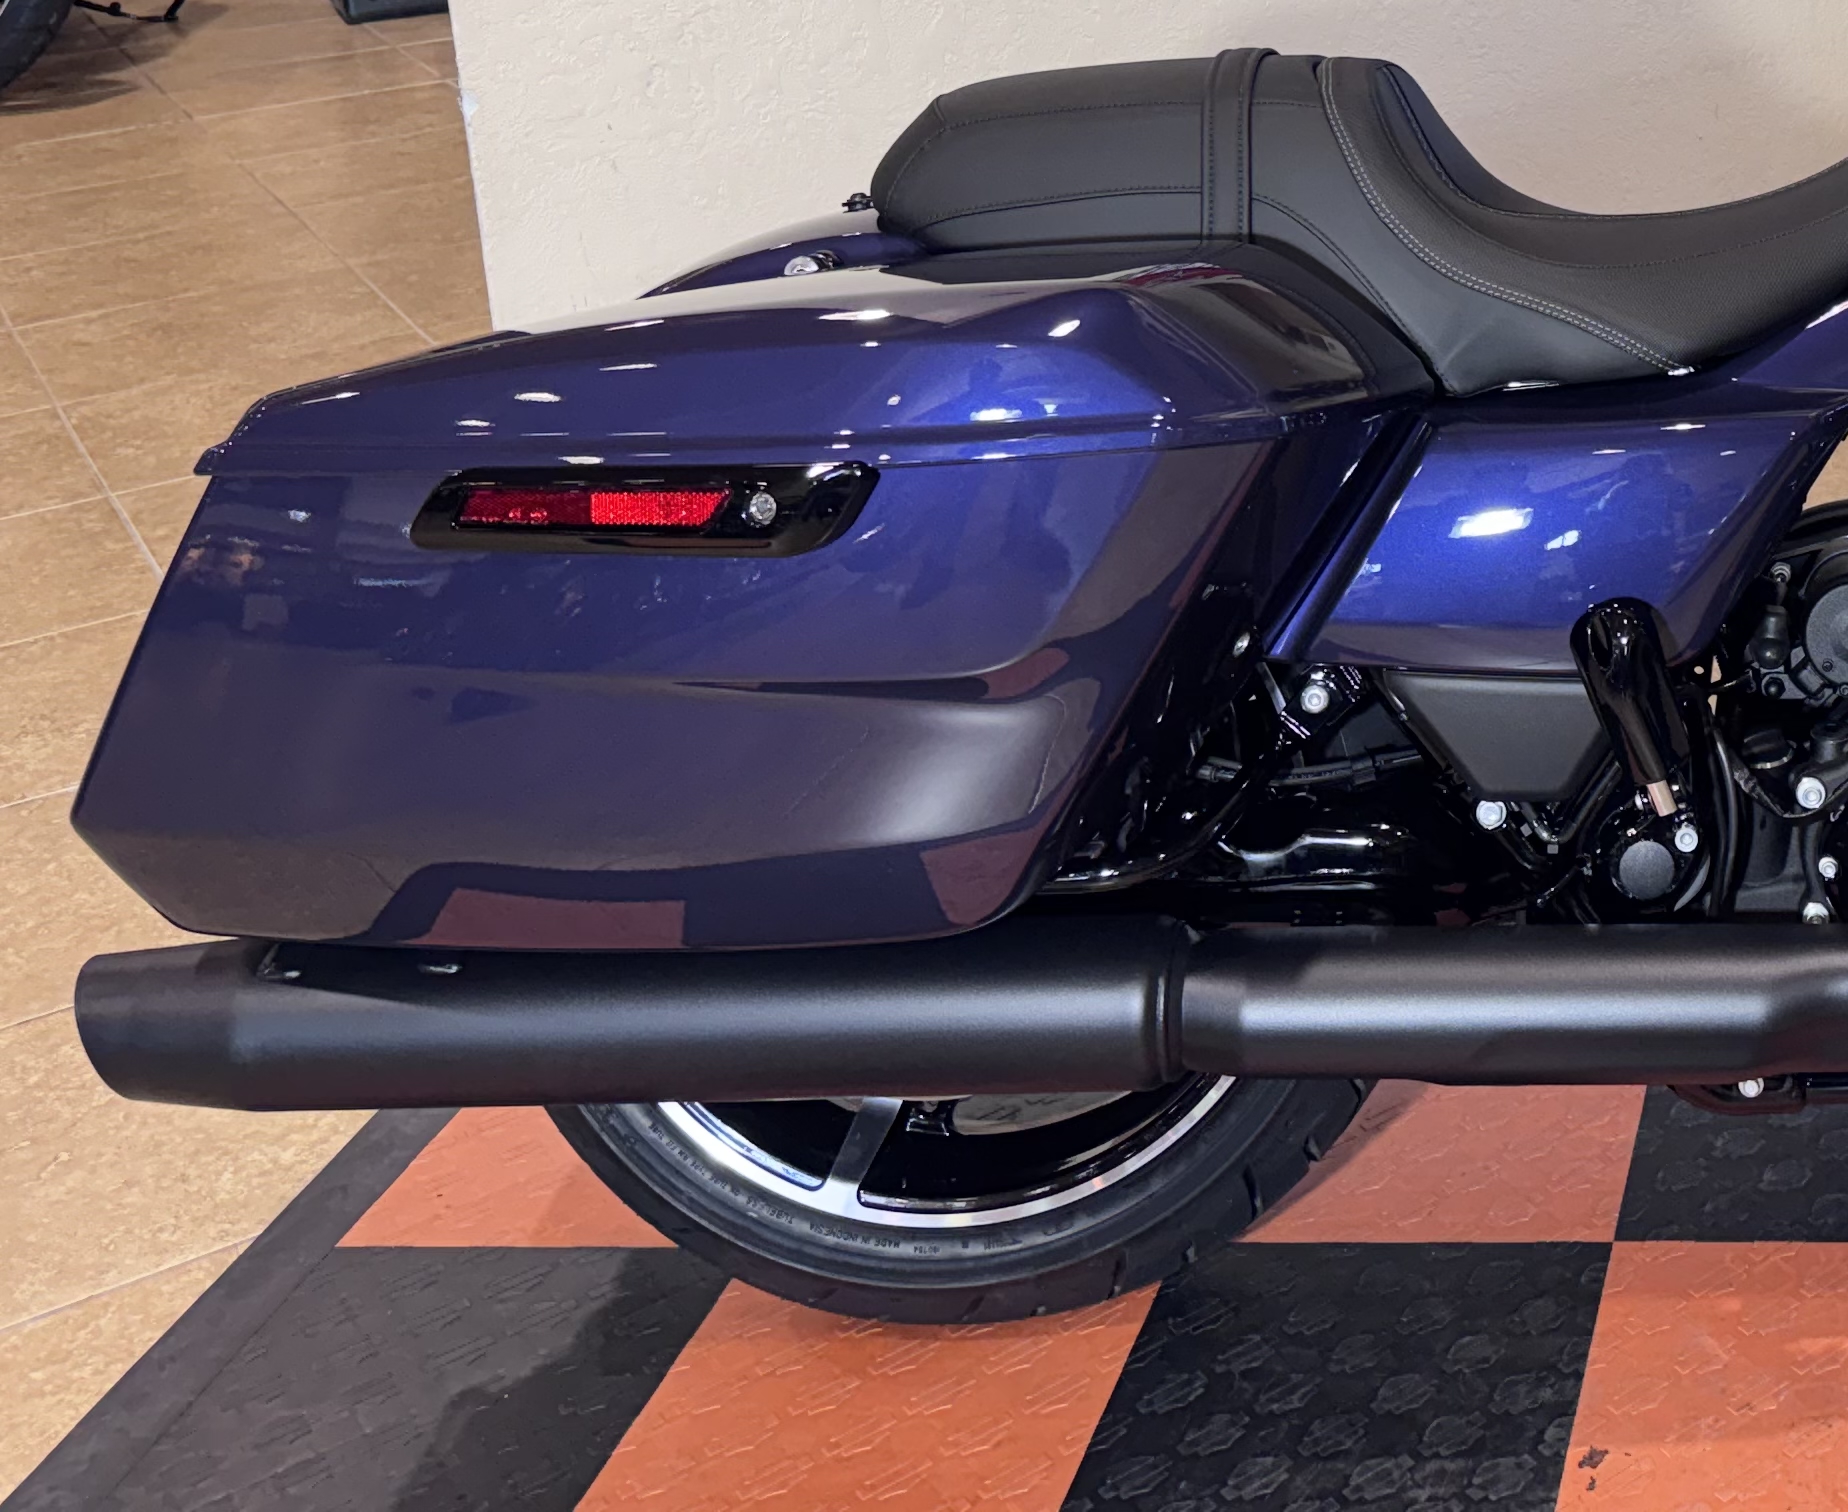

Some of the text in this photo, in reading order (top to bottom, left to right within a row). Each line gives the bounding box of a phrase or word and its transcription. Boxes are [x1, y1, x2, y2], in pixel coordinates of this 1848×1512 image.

[808, 1222, 901, 1250] MADE IN INDONESIA
